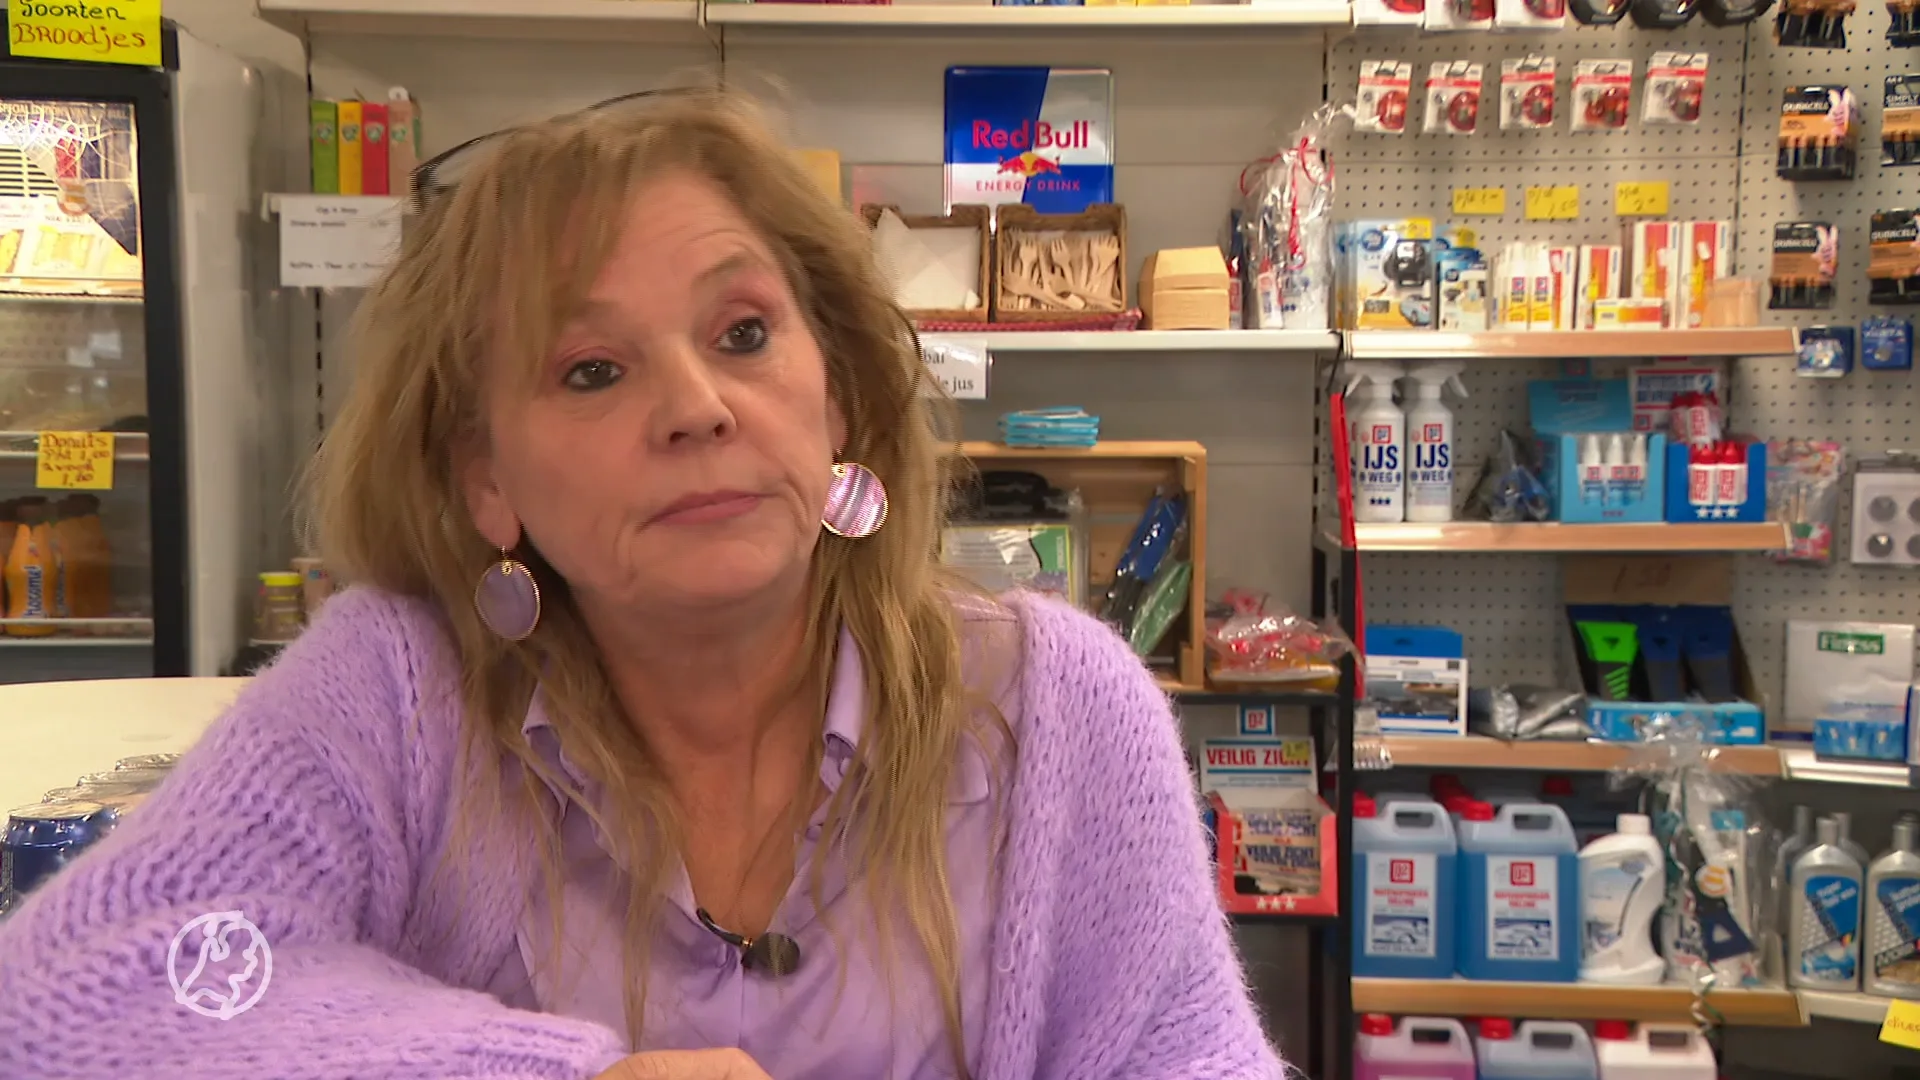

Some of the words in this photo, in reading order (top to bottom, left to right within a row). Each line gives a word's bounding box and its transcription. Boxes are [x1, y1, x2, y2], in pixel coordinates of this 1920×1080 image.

[973, 120, 1030, 149] Red
[1034, 120, 1089, 149] Bull
[975, 180, 1032, 192] ENERGY
[1037, 180, 1081, 192] DRINK
[952, 376, 974, 394] jus
[1364, 444, 1399, 470] IJS
[1415, 443, 1450, 469] IJS
[1368, 471, 1394, 483] WEG
[1206, 748, 1256, 766] VEILIG
